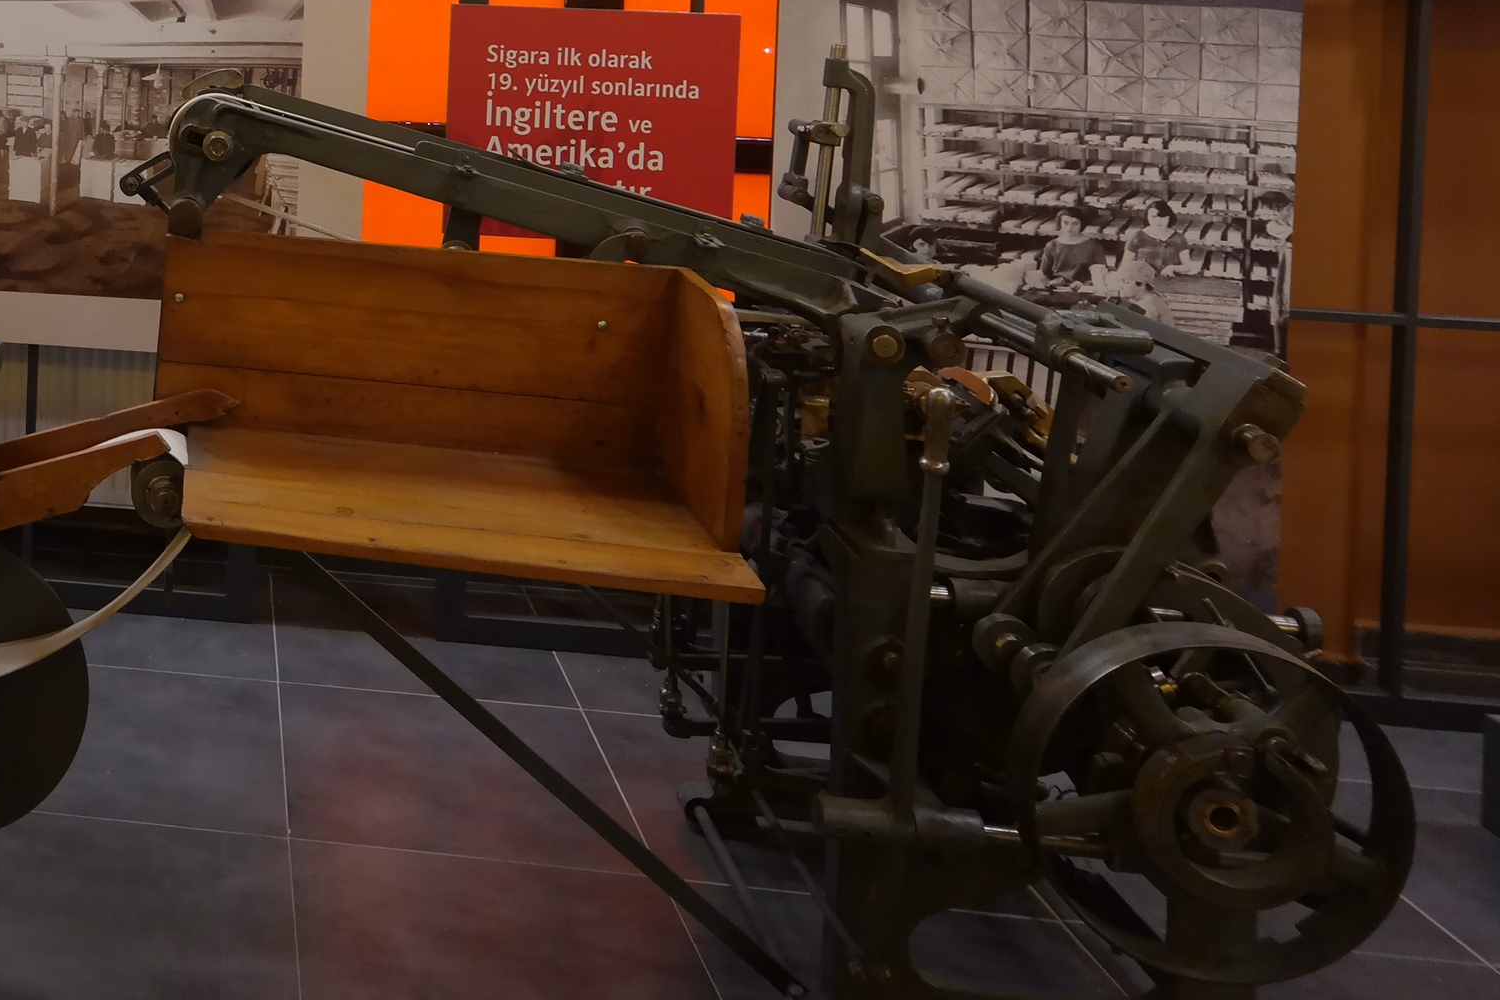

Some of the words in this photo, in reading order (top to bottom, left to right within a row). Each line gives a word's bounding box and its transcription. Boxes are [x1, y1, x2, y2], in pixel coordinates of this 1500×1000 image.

[487, 44, 550, 68] Sigara
[557, 47, 582, 67] ilk
[588, 49, 653, 70] olarak
[487, 72, 518, 91] 19.
[525, 74, 585, 98] yüzyıl
[591, 77, 700, 100] sonlarında
[485, 90, 619, 136] İngiltere
[628, 118, 653, 134] ve
